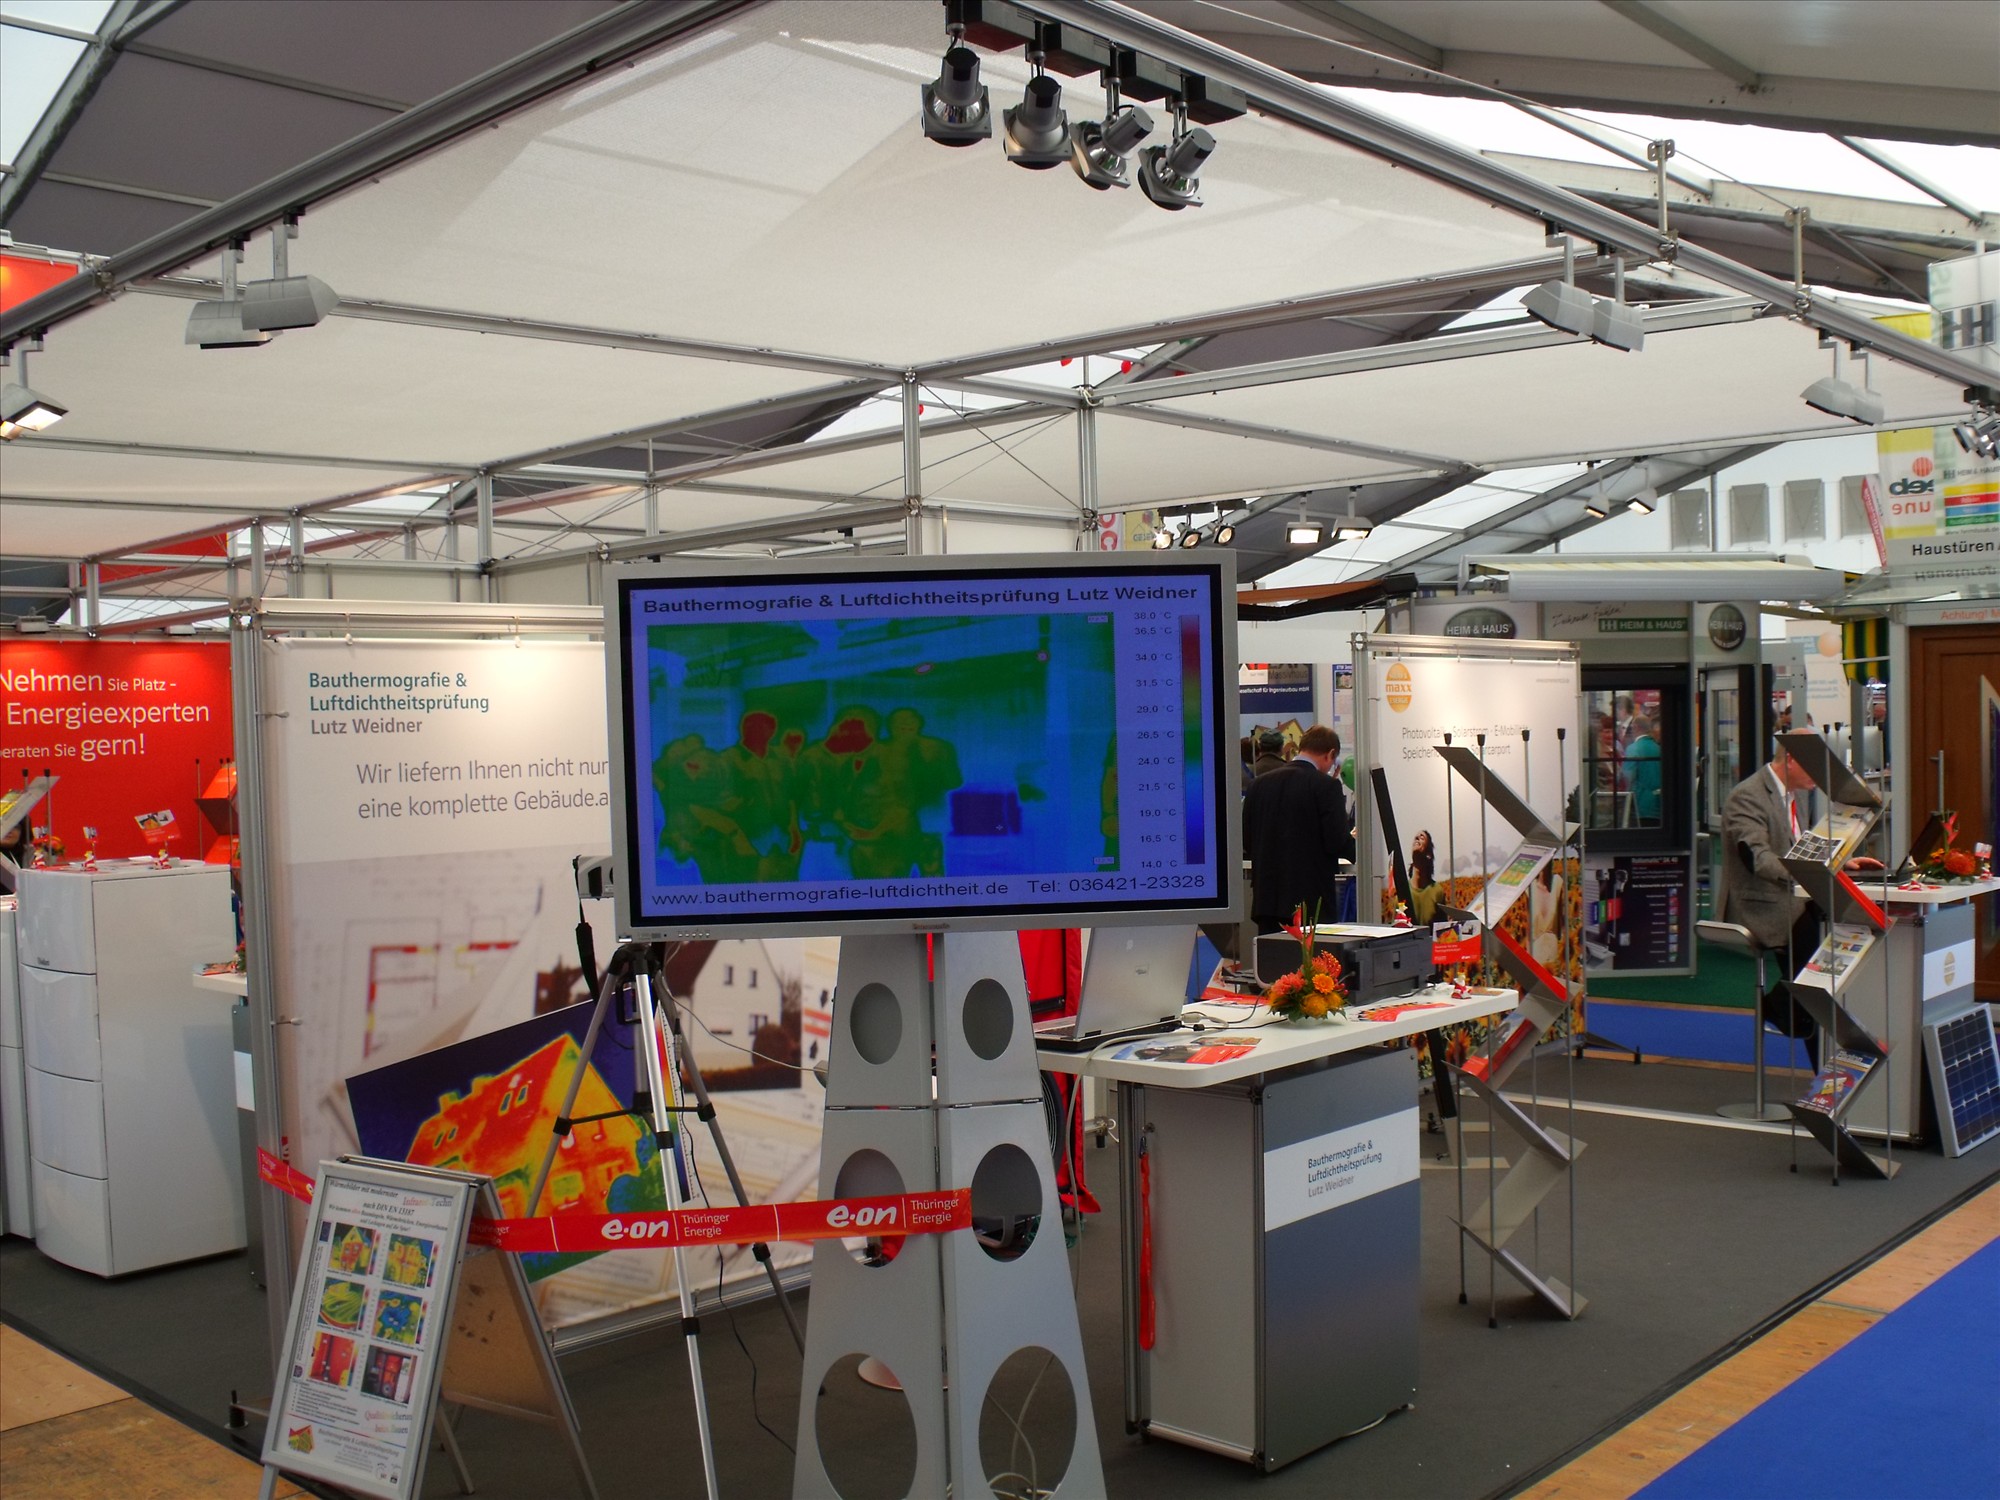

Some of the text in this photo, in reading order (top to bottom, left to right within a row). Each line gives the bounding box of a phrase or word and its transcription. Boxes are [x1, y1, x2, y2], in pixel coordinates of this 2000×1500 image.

[1912, 540, 1995, 557] Haustüren
[643, 586, 1198, 614] Bauthermografie & Luftdichtheitsprüfung Lutz Weidner
[1134, 612, 1156, 620] 38.0
[1447, 625, 1471, 636] HEIM
[1473, 624, 1480, 635] &
[1620, 620, 1645, 630] HEIM
[1647, 620, 1653, 630] &
[1135, 627, 1157, 636] 36.5
[1135, 653, 1157, 662] 34.0
[0, 668, 103, 692] Nehmen
[108, 678, 129, 691] Sie
[133, 678, 166, 692] Platz
[309, 672, 467, 691] Bauthermografie &
[1136, 679, 1158, 688] 31.5
[1386, 683, 1412, 693] maxx
[310, 693, 490, 714] Luftdichtheitsprüfung
[1137, 705, 1158, 714] 29.0
[7, 702, 210, 730] Energieexperten
[311, 717, 423, 735] Lutz Weidner
[1137, 730, 1159, 740] 26.5
[54, 744, 76, 757] Sie
[81, 733, 145, 762] gern!
[1138, 757, 1160, 766] 24.0
[357, 757, 609, 784] Wir liefern Ihnen nicht nur
[1139, 783, 1160, 792] 21.5
[358, 798, 402, 819] eine
[408, 792, 508, 819] komplette
[1140, 809, 1161, 818] 19.0
[1141, 834, 1161, 844] 16.5
[1141, 860, 1162, 869] 14.0
[651, 875, 1206, 905] www.bauthermografie-luftdichtheit.de Tel: 036421-23328
[1308, 1140, 1373, 1169] Bauthermografie &
[1308, 1152, 1383, 1184] Luftdichtheitsprüfung
[1308, 1175, 1354, 1198] Lutz Weidner
[910, 1198, 960, 1211] Thüringer
[682, 1213, 730, 1225] Thüringer
[912, 1211, 952, 1225] Energie
[684, 1226, 722, 1238] Energie
